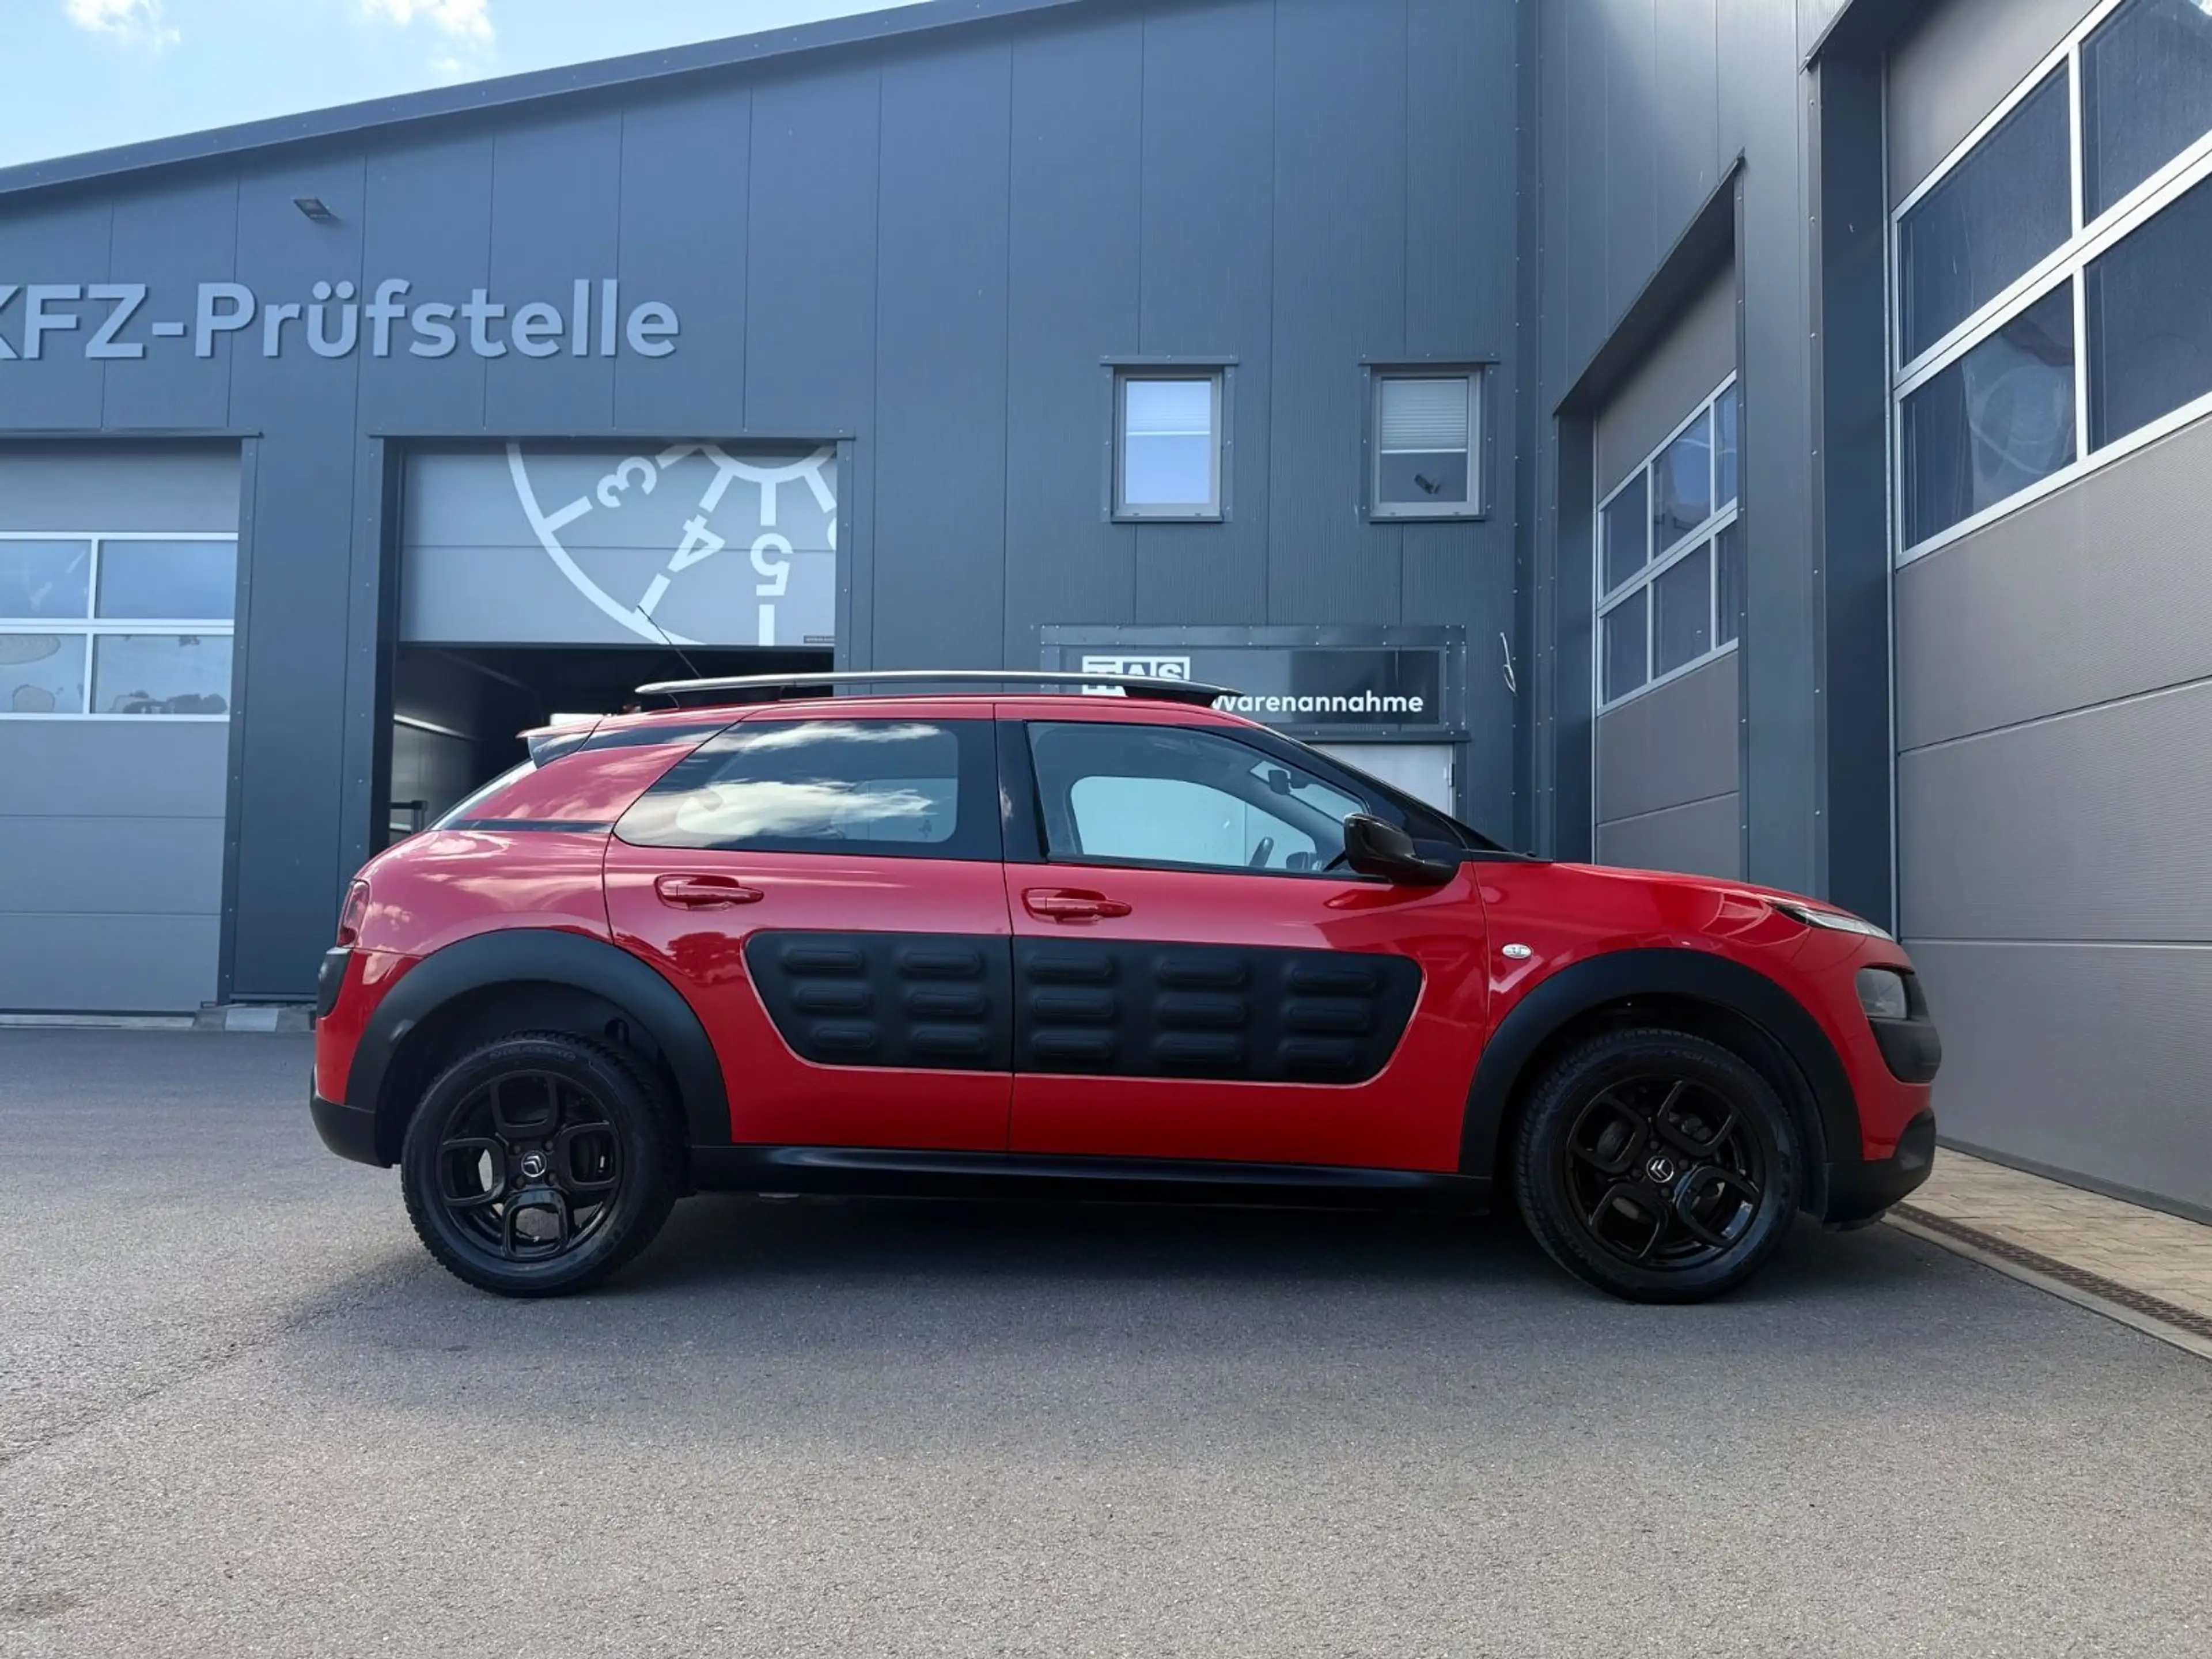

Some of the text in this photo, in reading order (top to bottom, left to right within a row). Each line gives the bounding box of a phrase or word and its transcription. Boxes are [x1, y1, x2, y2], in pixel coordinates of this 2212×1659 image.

[597, 456, 657, 508] 3
[666, 514, 726, 573] 4
[750, 532, 794, 596] 5
